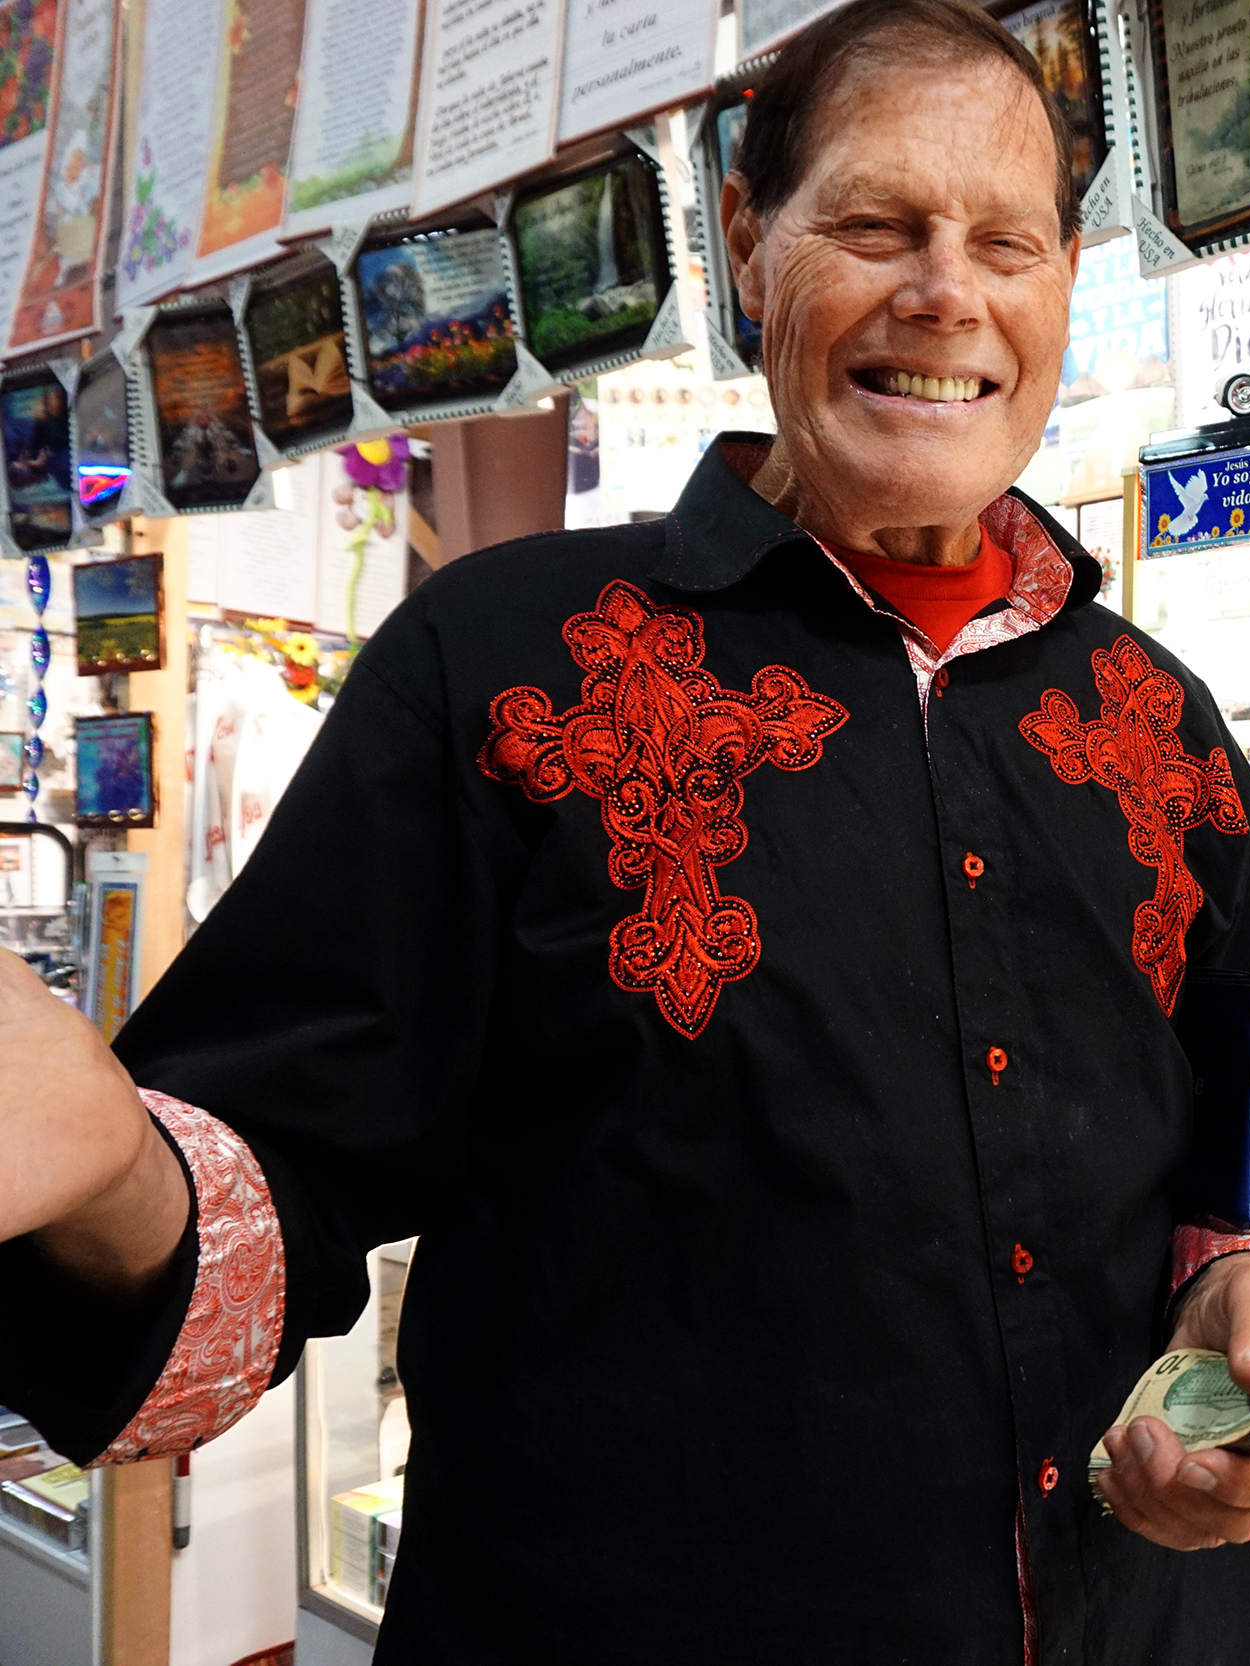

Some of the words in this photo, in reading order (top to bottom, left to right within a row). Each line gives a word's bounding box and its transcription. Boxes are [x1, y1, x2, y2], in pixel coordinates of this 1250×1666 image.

[1170, 32, 1213, 62] Nuestro
[572, 44, 682, 103] personalmente.
[1084, 192, 1100, 220] echo
[1100, 176, 1110, 192] en
[1092, 196, 1113, 228] USA
[1136, 216, 1164, 248] Hecho
[1163, 246, 1176, 260] en
[1138, 239, 1161, 267] USA
[1212, 472, 1230, 487] Yo
[1225, 459, 1248, 472] Jesús
[1155, 1354, 1190, 1375] 10
